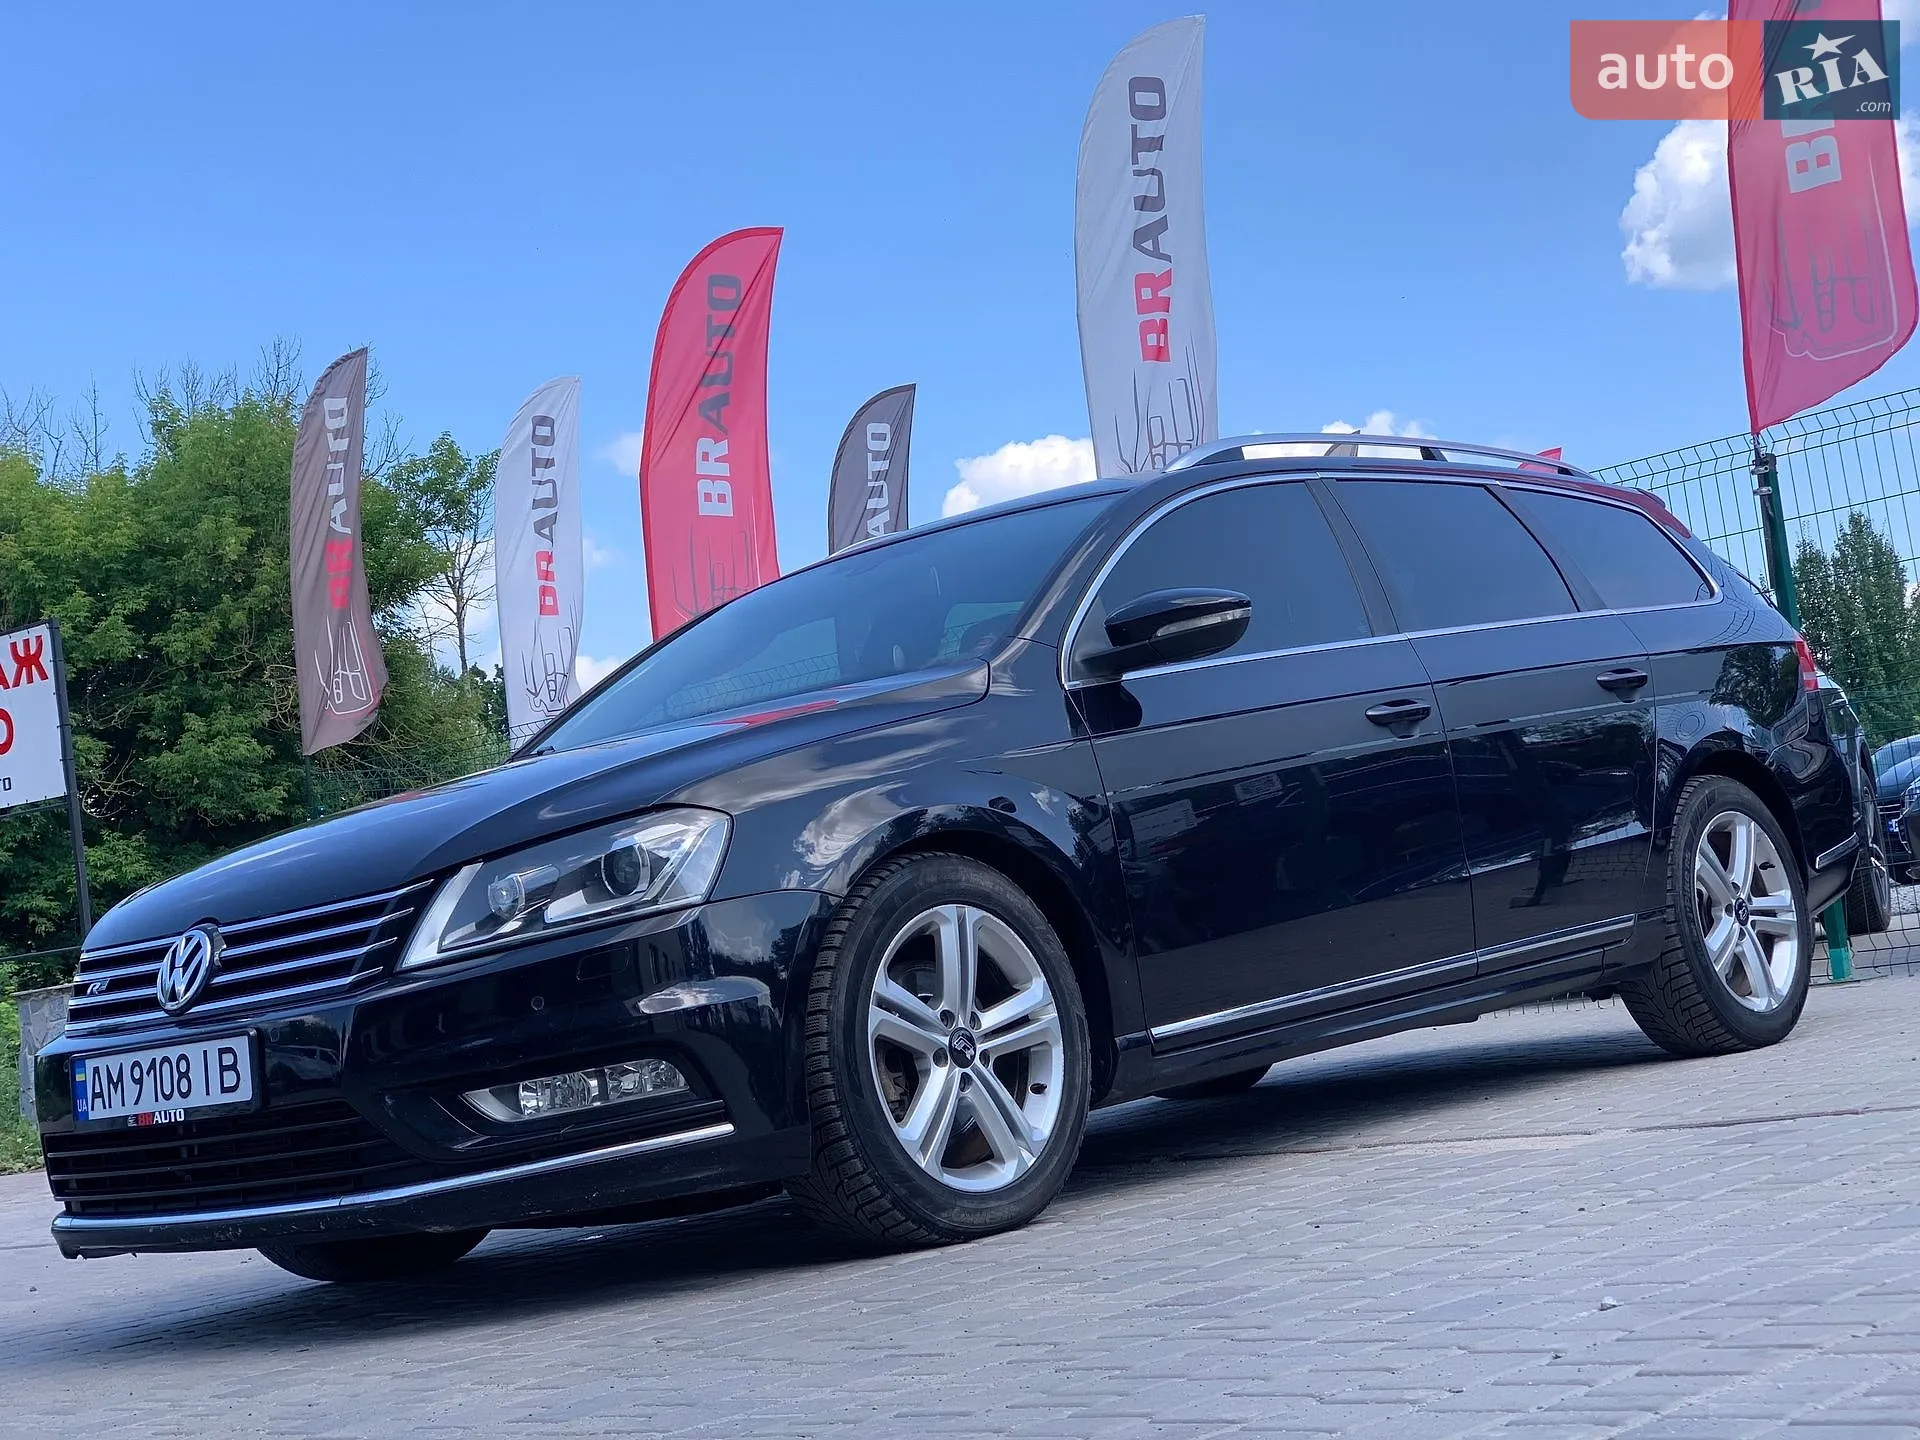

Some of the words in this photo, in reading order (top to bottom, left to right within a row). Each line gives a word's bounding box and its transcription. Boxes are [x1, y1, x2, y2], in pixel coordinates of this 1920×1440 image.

[1128, 75, 1173, 364] BRAUTO
[695, 273, 743, 518] BRAUTO
[323, 397, 353, 610] BRAUTO
[531, 414, 560, 617] BRAUTO
[76, 1099, 88, 1113] UA
[90, 1061, 127, 1112] AM
[130, 1053, 192, 1106] 9108
